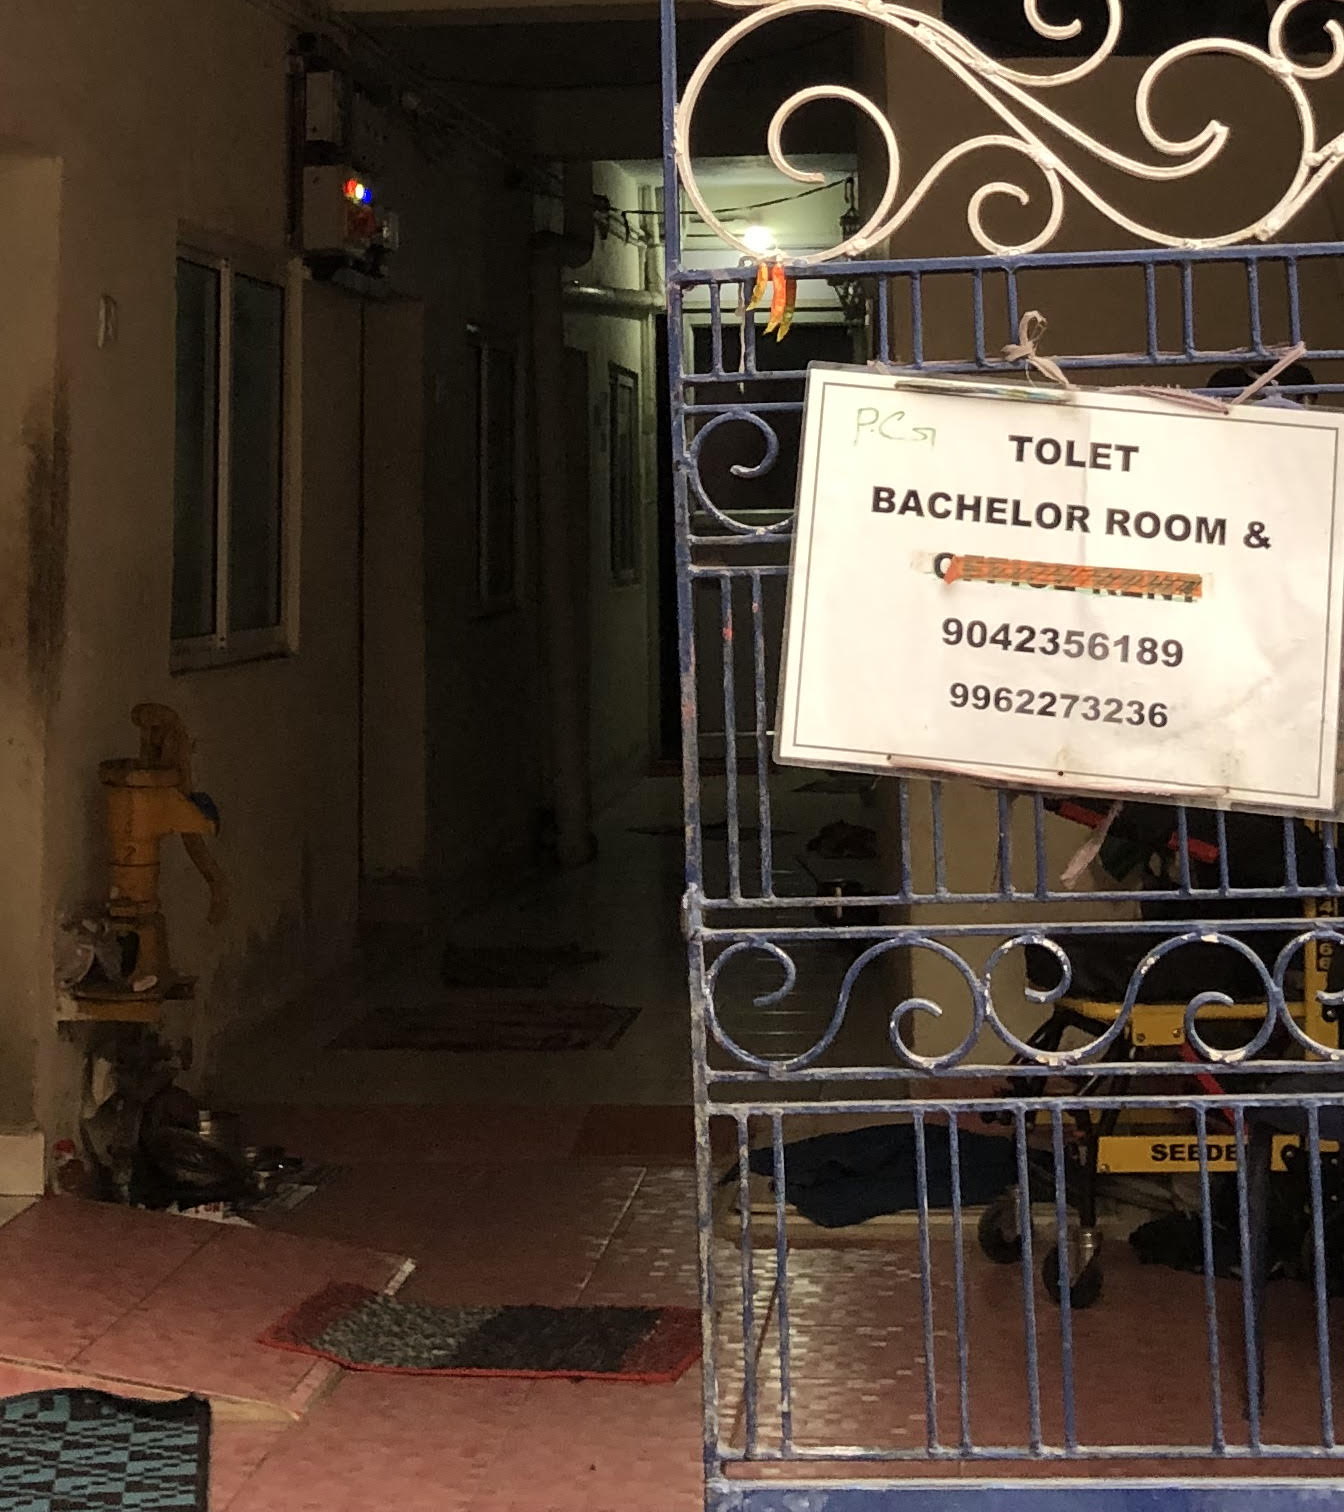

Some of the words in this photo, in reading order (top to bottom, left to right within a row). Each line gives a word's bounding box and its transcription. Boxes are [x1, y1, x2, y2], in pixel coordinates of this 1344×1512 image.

[1008, 434, 1140, 473] TOLET
[871, 485, 1090, 534] BACHELOR
[1105, 507, 1227, 546] ROOM
[1243, 520, 1272, 550] &
[942, 617, 1184, 668] 9042356189
[950, 682, 1168, 728] 9962273236
[1151, 1143, 1247, 1162] SEEDE
